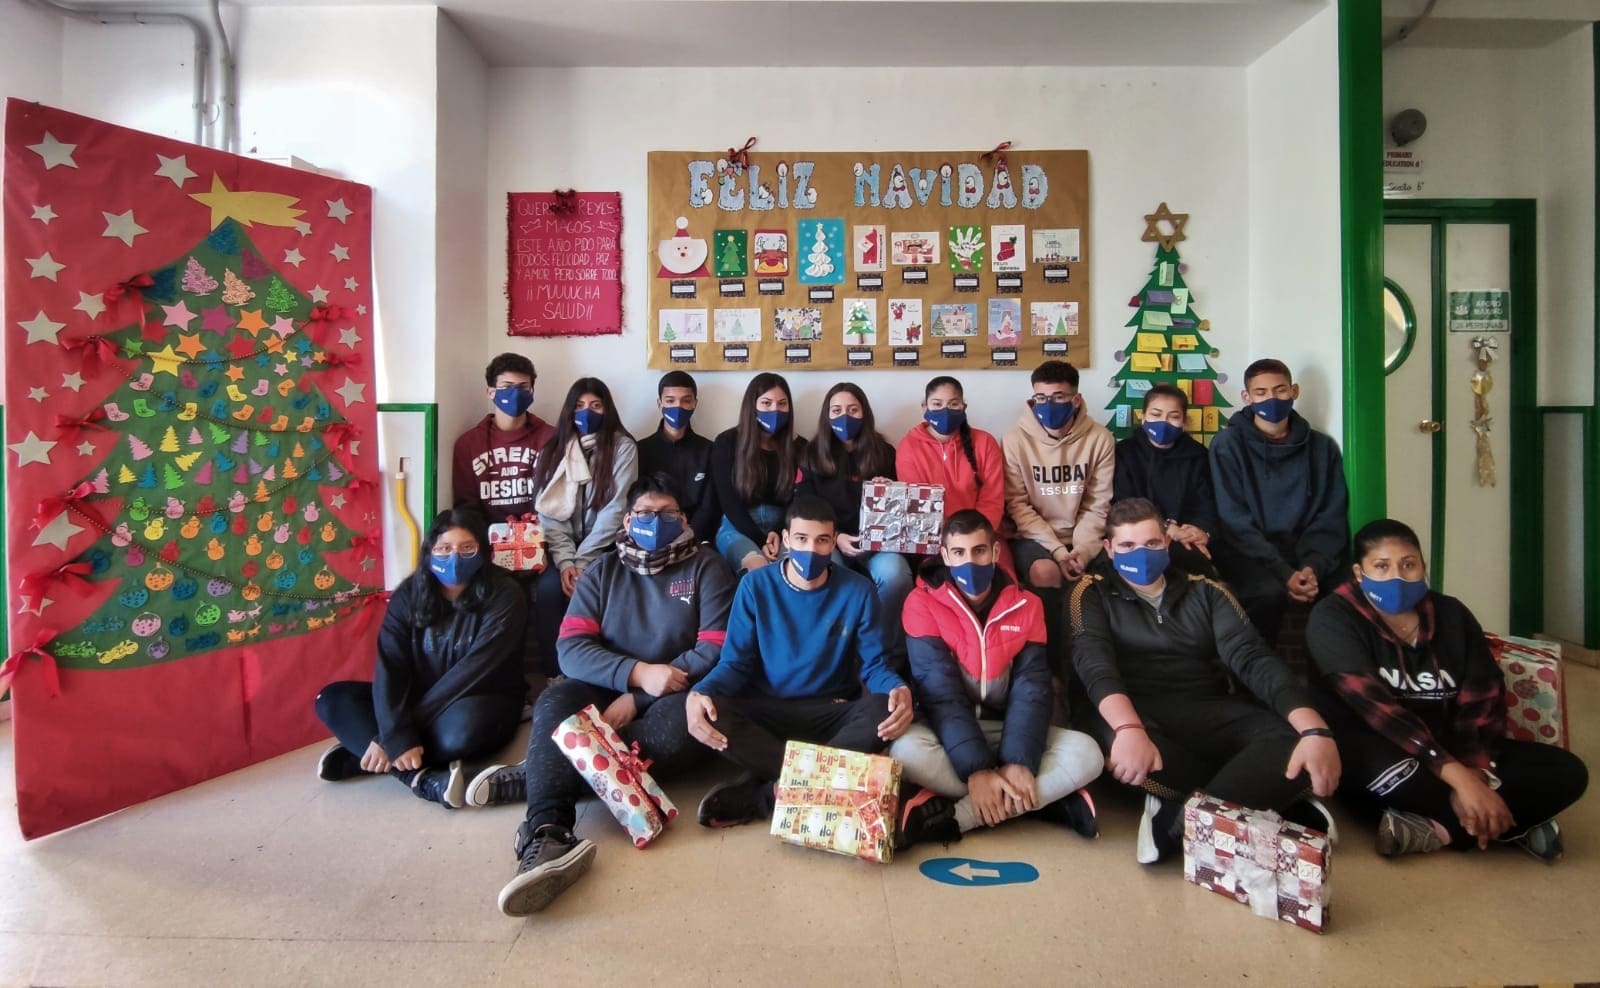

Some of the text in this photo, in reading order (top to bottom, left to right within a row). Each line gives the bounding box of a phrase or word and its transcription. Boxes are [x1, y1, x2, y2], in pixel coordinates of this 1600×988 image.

[687, 158, 1049, 212] FELIZ NAVIDAD
[517, 199, 556, 216] QUER
[516, 238, 544, 253] ESTE
[574, 237, 595, 251] PIDO
[554, 268, 575, 281] PERO
[500, 465, 519, 477] AND
[1040, 484, 1084, 496] ISSUES
[1379, 667, 1456, 692] NASA
